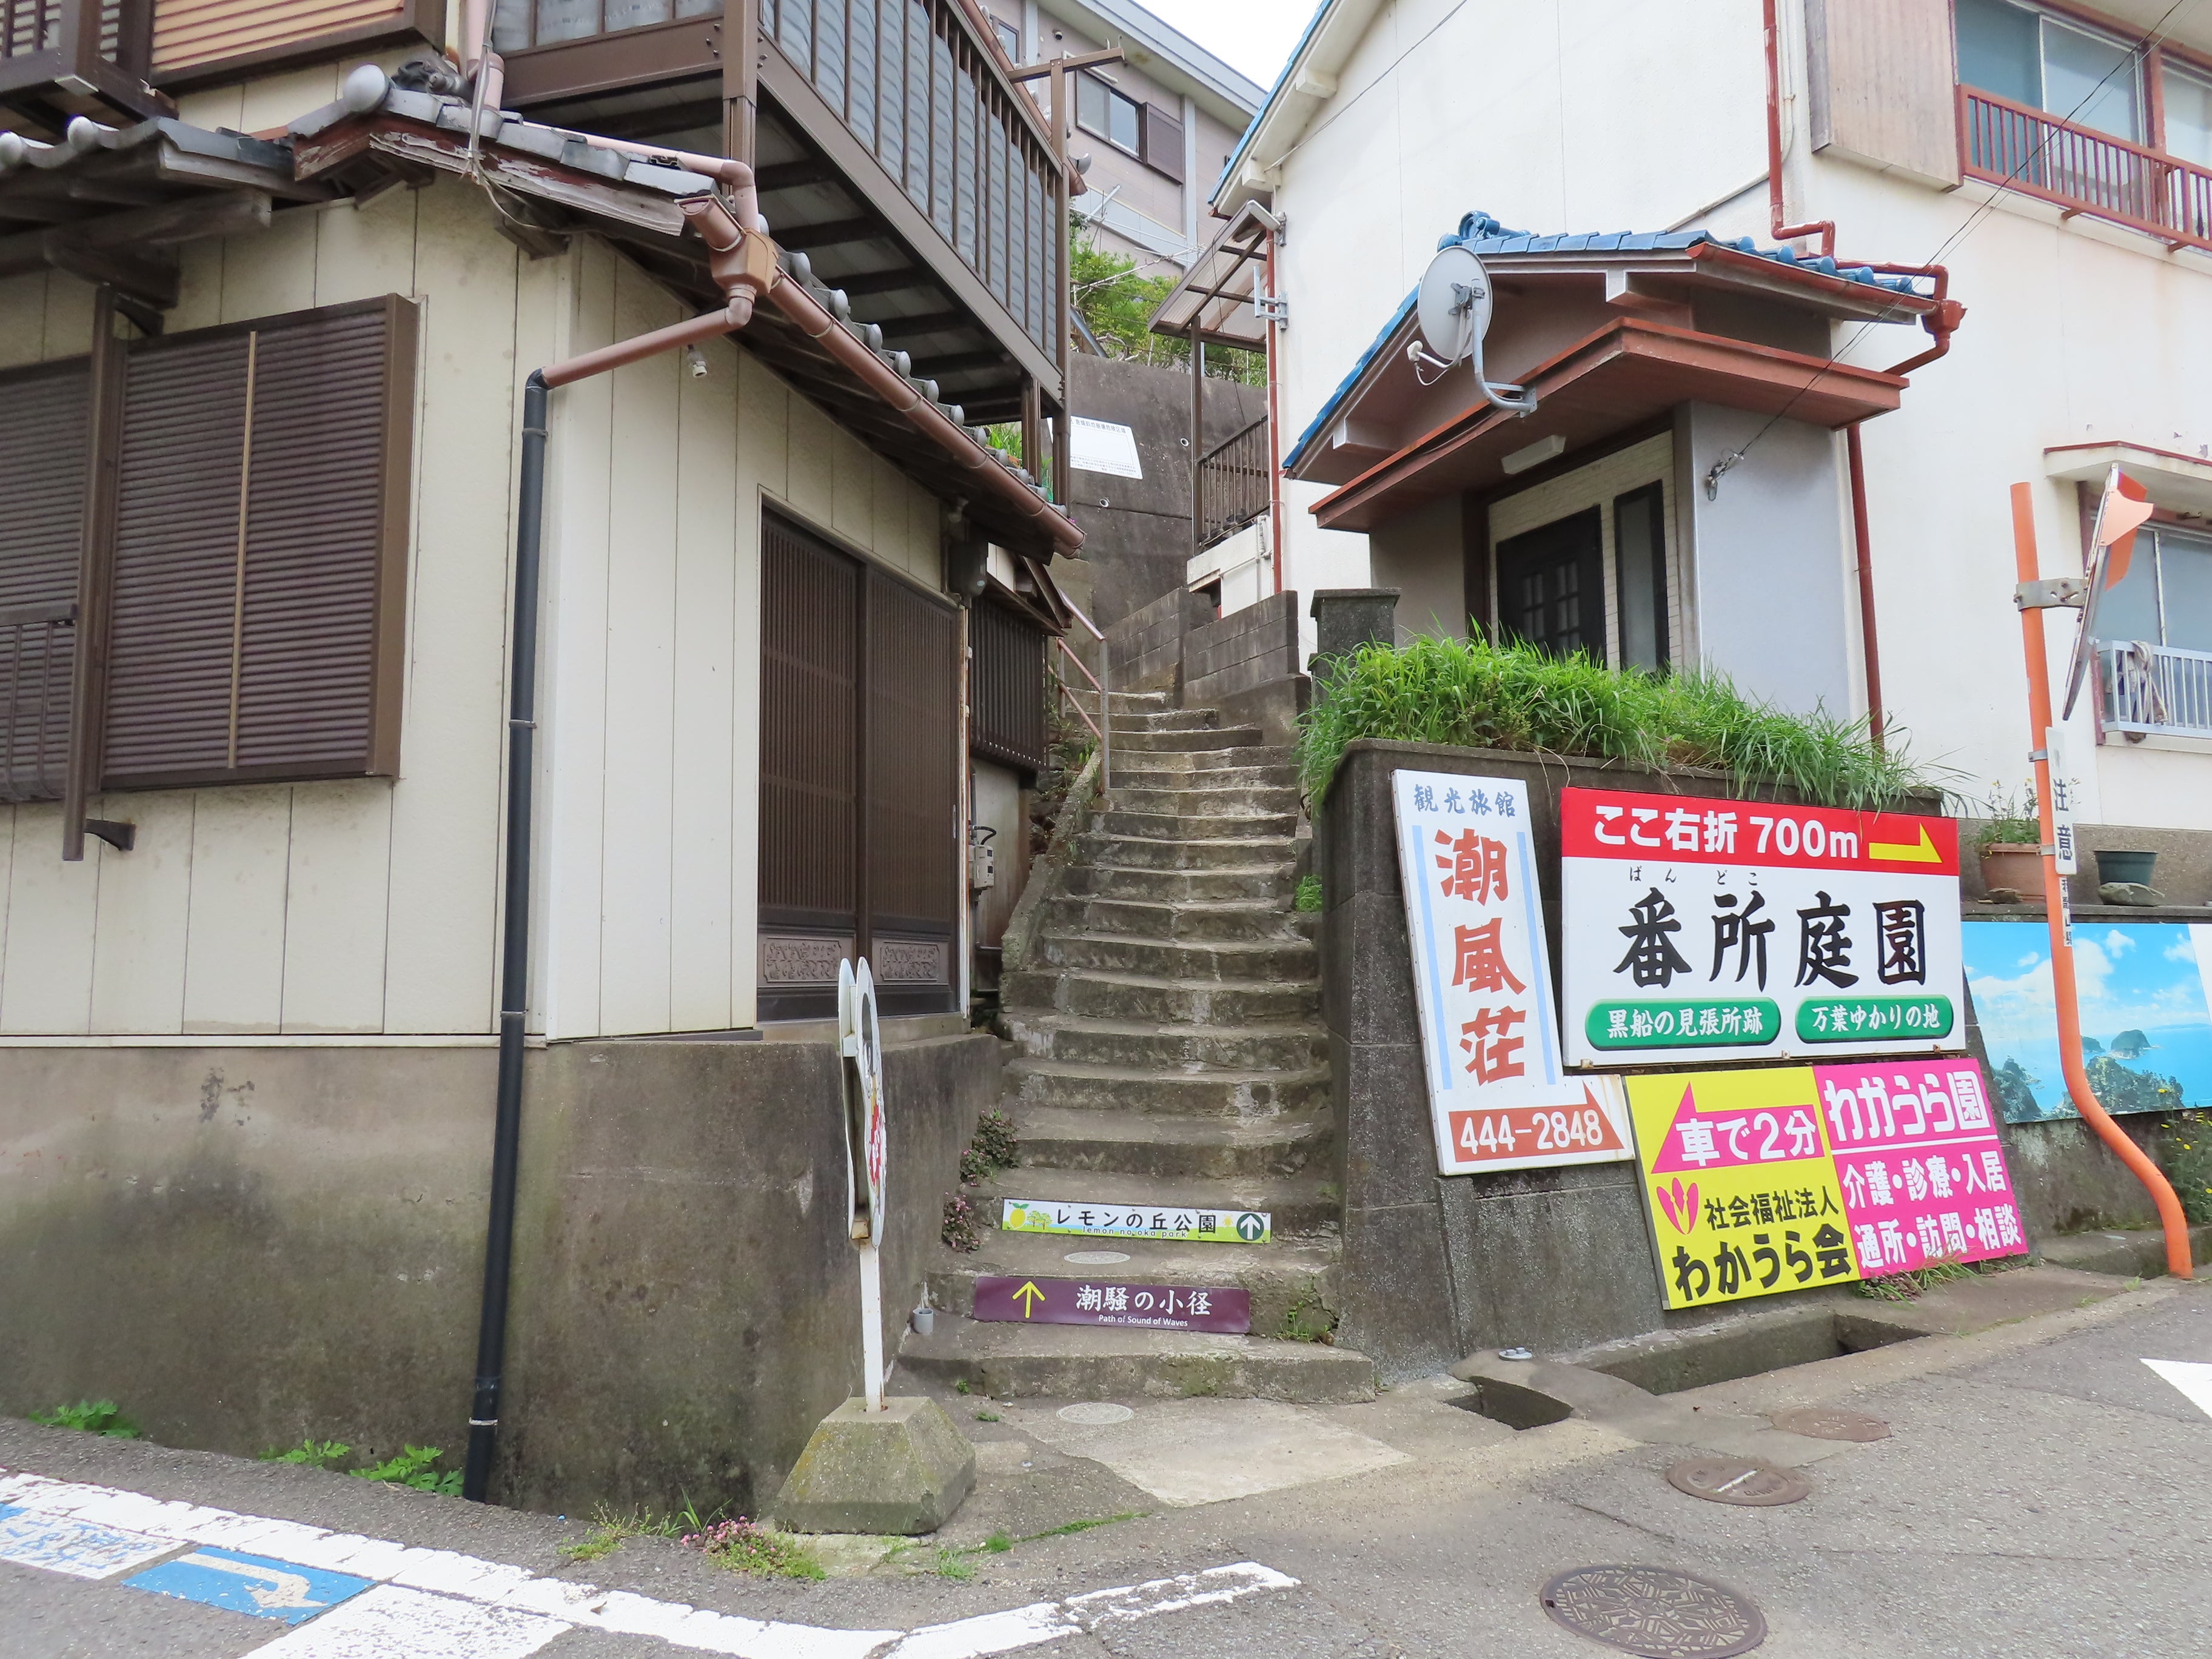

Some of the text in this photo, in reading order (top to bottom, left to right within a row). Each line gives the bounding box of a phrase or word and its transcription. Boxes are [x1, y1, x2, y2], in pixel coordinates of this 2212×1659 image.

[1414, 785, 1516, 817] 観光旅館
[2052, 777, 2073, 861] 注意
[1594, 804, 1858, 859] ここ右折 700m
[1629, 865, 1758, 886] ばんどこ
[1435, 828, 1527, 1087] 潮風荘
[1613, 887, 1926, 993] 番所庭園
[1606, 1005, 1763, 1040] 黒船の見張所跡
[1811, 1005, 1940, 1033] 万葉ゆかりの地
[1824, 1070, 1991, 1142] わかうら園
[1461, 1108, 1603, 1155] 444-2848
[1675, 1110, 1817, 1167] 車で2分
[1842, 1150, 2007, 1210] 介護・診療・入居
[1057, 1208, 1216, 1234] レモンの丘公園
[1704, 1185, 1840, 1231] 社会福祉法人
[1082, 1225, 1114, 1235] lemon
[1161, 1230, 1188, 1239] park
[1854, 1202, 2022, 1269] 通所・訪問・相談
[1671, 1223, 1852, 1302] わかうら会
[1076, 1284, 1213, 1316] 潮騒の小径
[1099, 1314, 1116, 1323] Path
[1127, 1316, 1151, 1325] Sound
[1162, 1318, 1188, 1327] Waves
